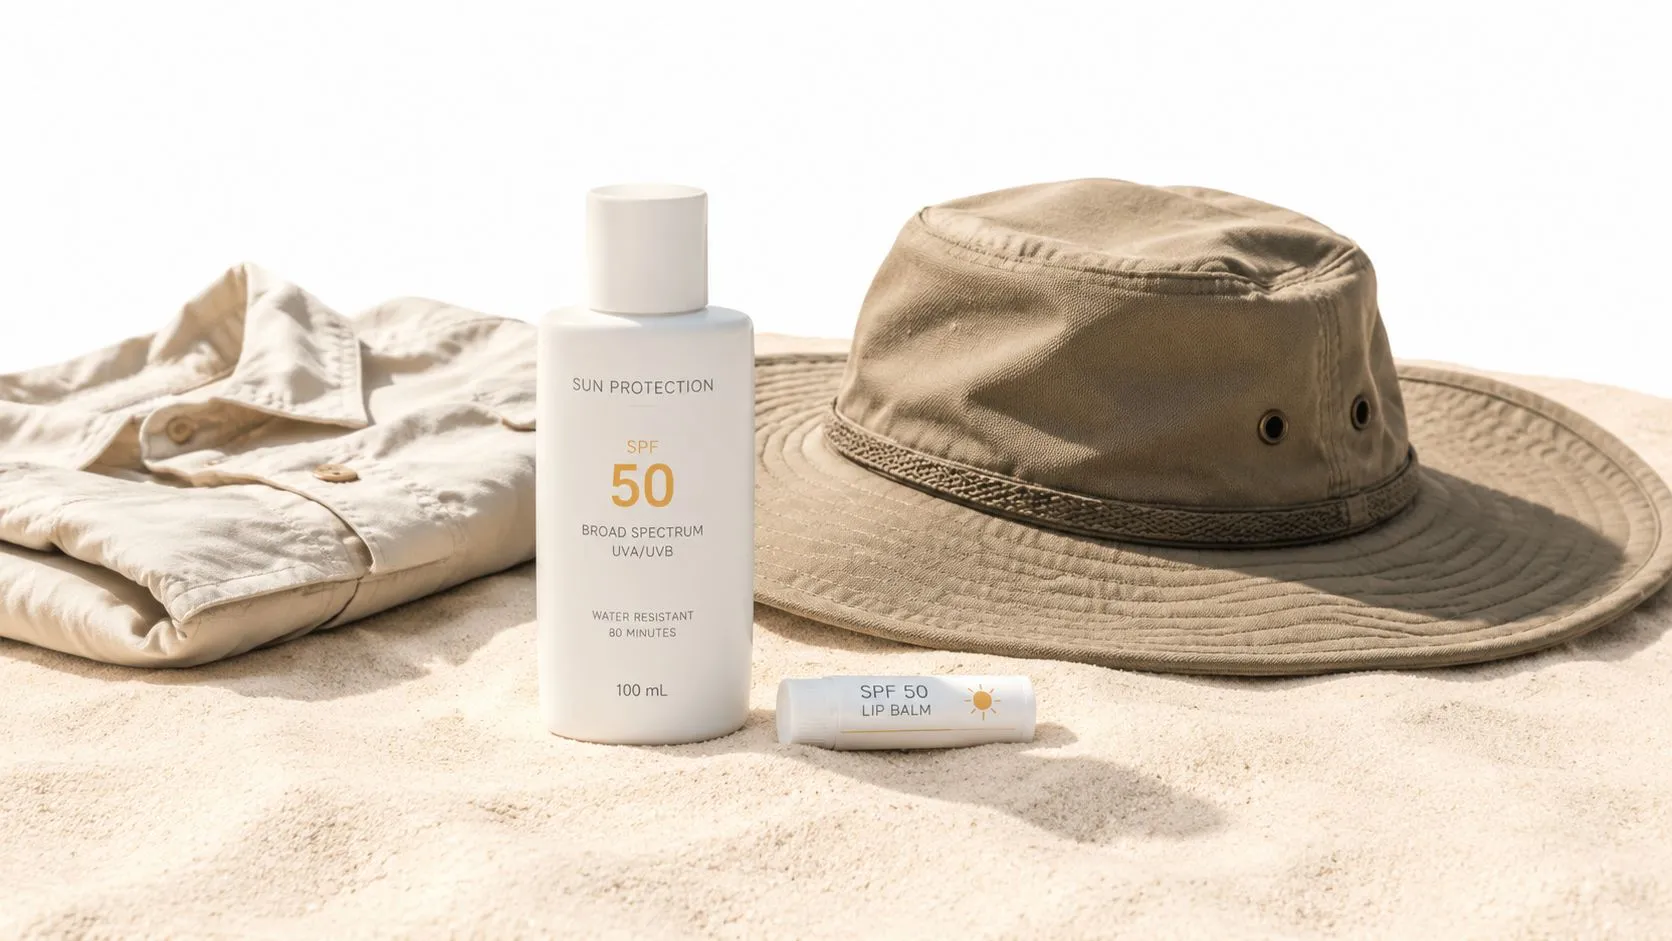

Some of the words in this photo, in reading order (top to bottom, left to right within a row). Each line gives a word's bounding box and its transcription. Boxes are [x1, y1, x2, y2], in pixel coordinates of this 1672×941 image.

[572, 377, 604, 394] SUN
[609, 377, 714, 395] PROTECTION
[626, 439, 659, 455] SPF
[610, 462, 675, 509] 50
[581, 523, 627, 539] BROAD
[631, 523, 704, 539] SPECTRUM
[612, 544, 674, 560] UVA/UVB
[591, 609, 630, 622] WATER
[633, 609, 694, 622] RESISTANT
[608, 627, 623, 638] 80
[626, 627, 677, 638] MINUTES
[616, 683, 641, 697] 100
[645, 683, 668, 697] mL
[860, 684, 896, 700] SPF
[903, 684, 929, 700] 50
[861, 704, 885, 717] LIP
[890, 703, 932, 716] BALM
